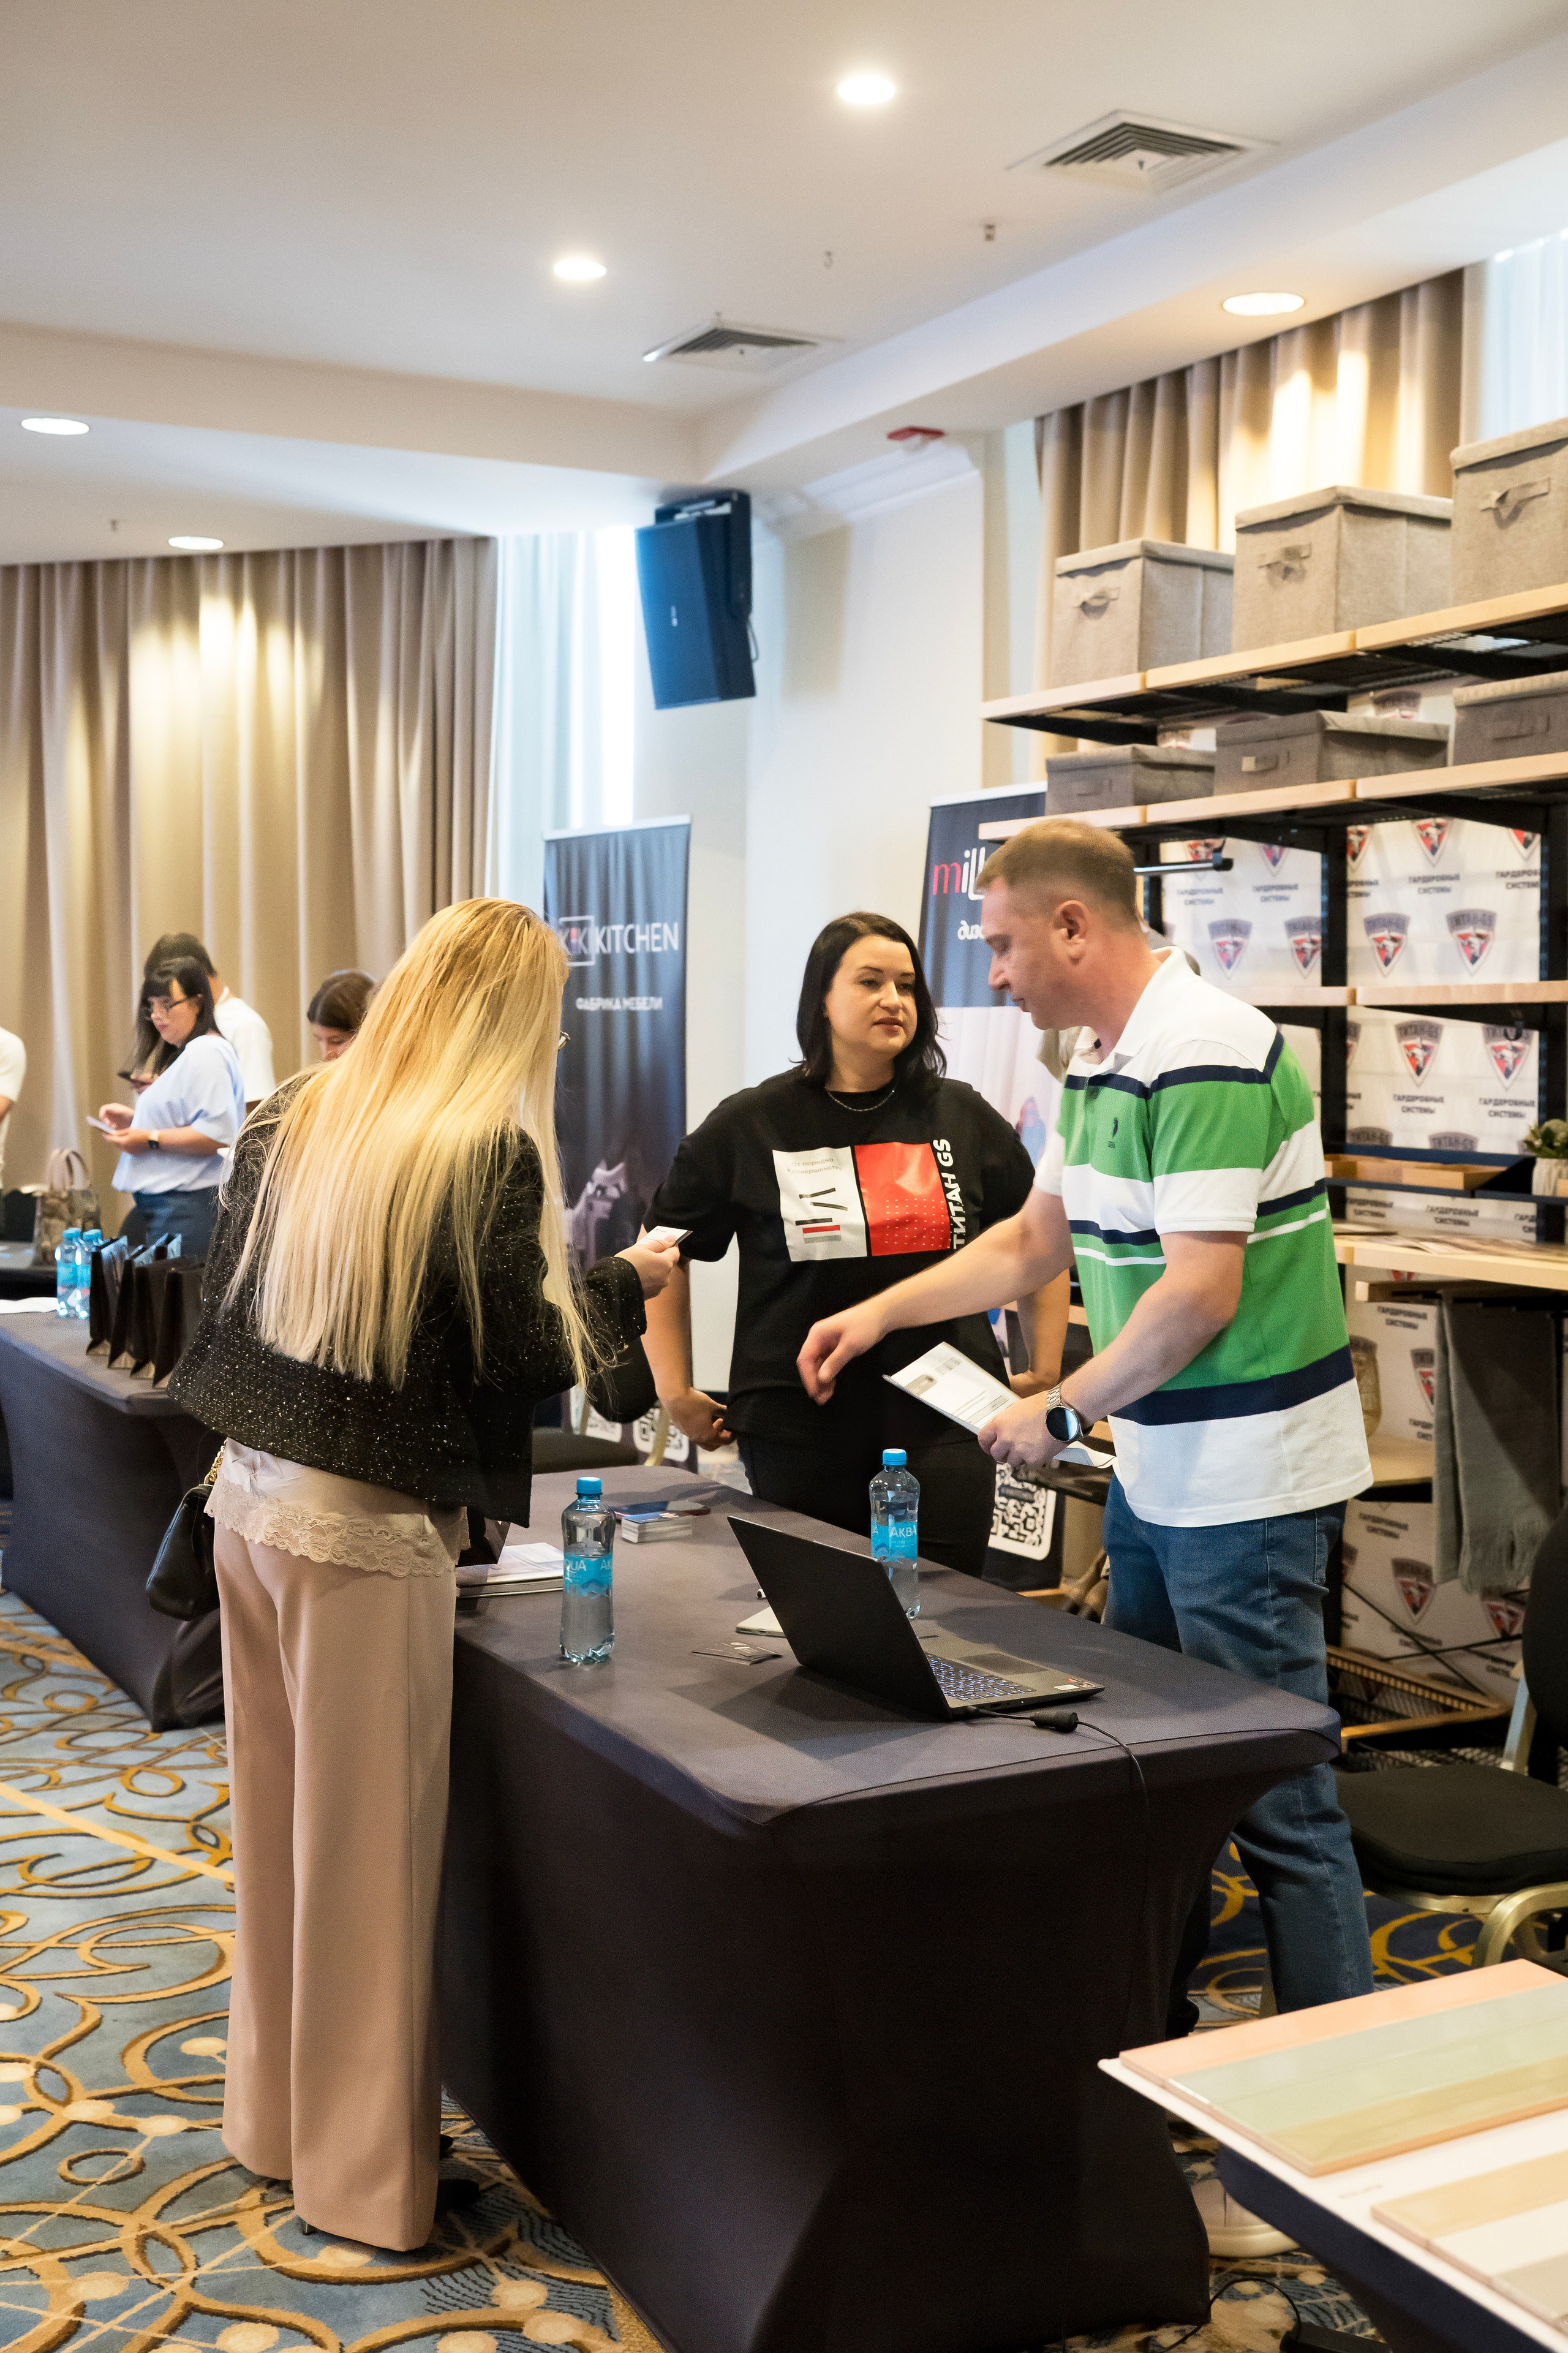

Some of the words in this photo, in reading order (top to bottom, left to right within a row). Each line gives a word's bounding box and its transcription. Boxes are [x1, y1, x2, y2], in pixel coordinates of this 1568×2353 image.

[933, 1139, 954, 1167] GS
[941, 1173, 966, 1250] ТИТАН
[564, 1558, 587, 1573] QUA
